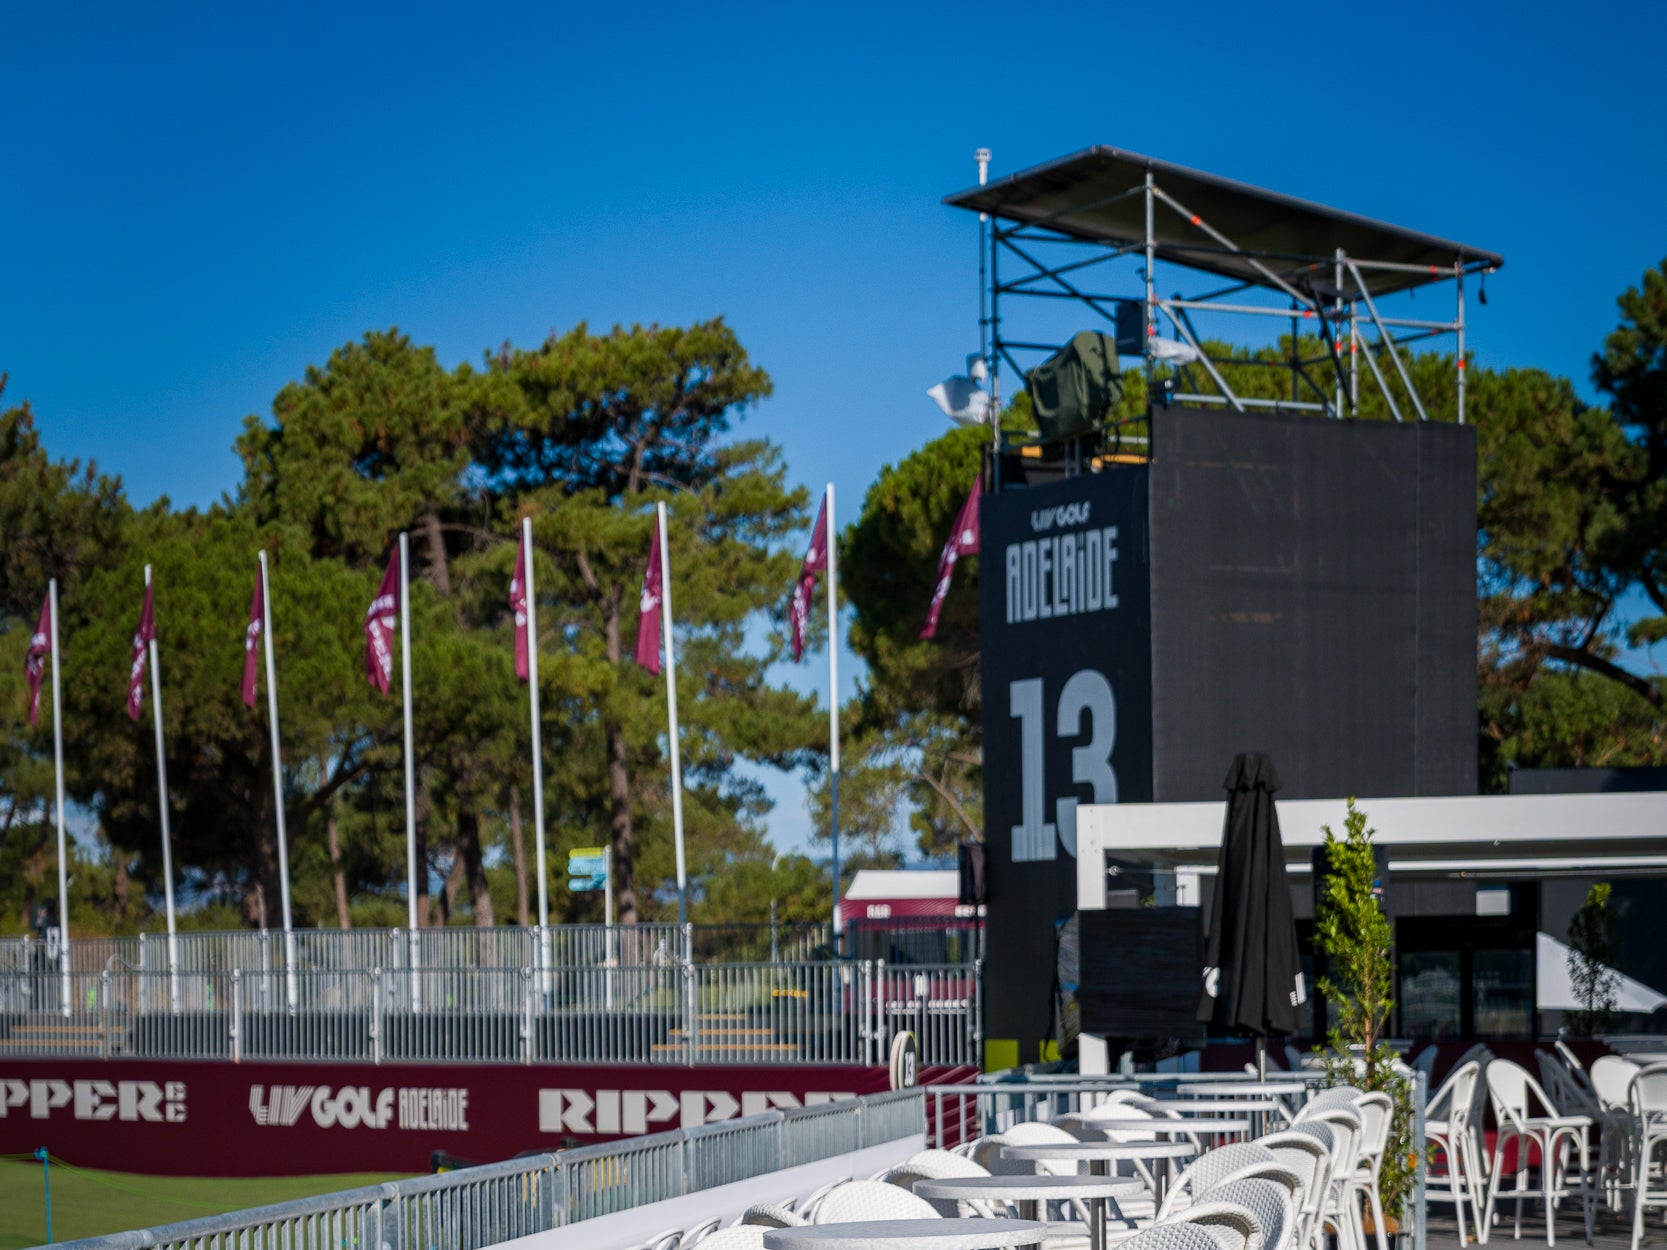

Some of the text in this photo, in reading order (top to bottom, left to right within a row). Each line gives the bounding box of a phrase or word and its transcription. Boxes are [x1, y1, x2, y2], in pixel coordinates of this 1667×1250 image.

[1055, 500, 1092, 528] GOLF
[1009, 668, 1119, 863] 13
[249, 1084, 469, 1131] LIV GOLF ADELAIDE
